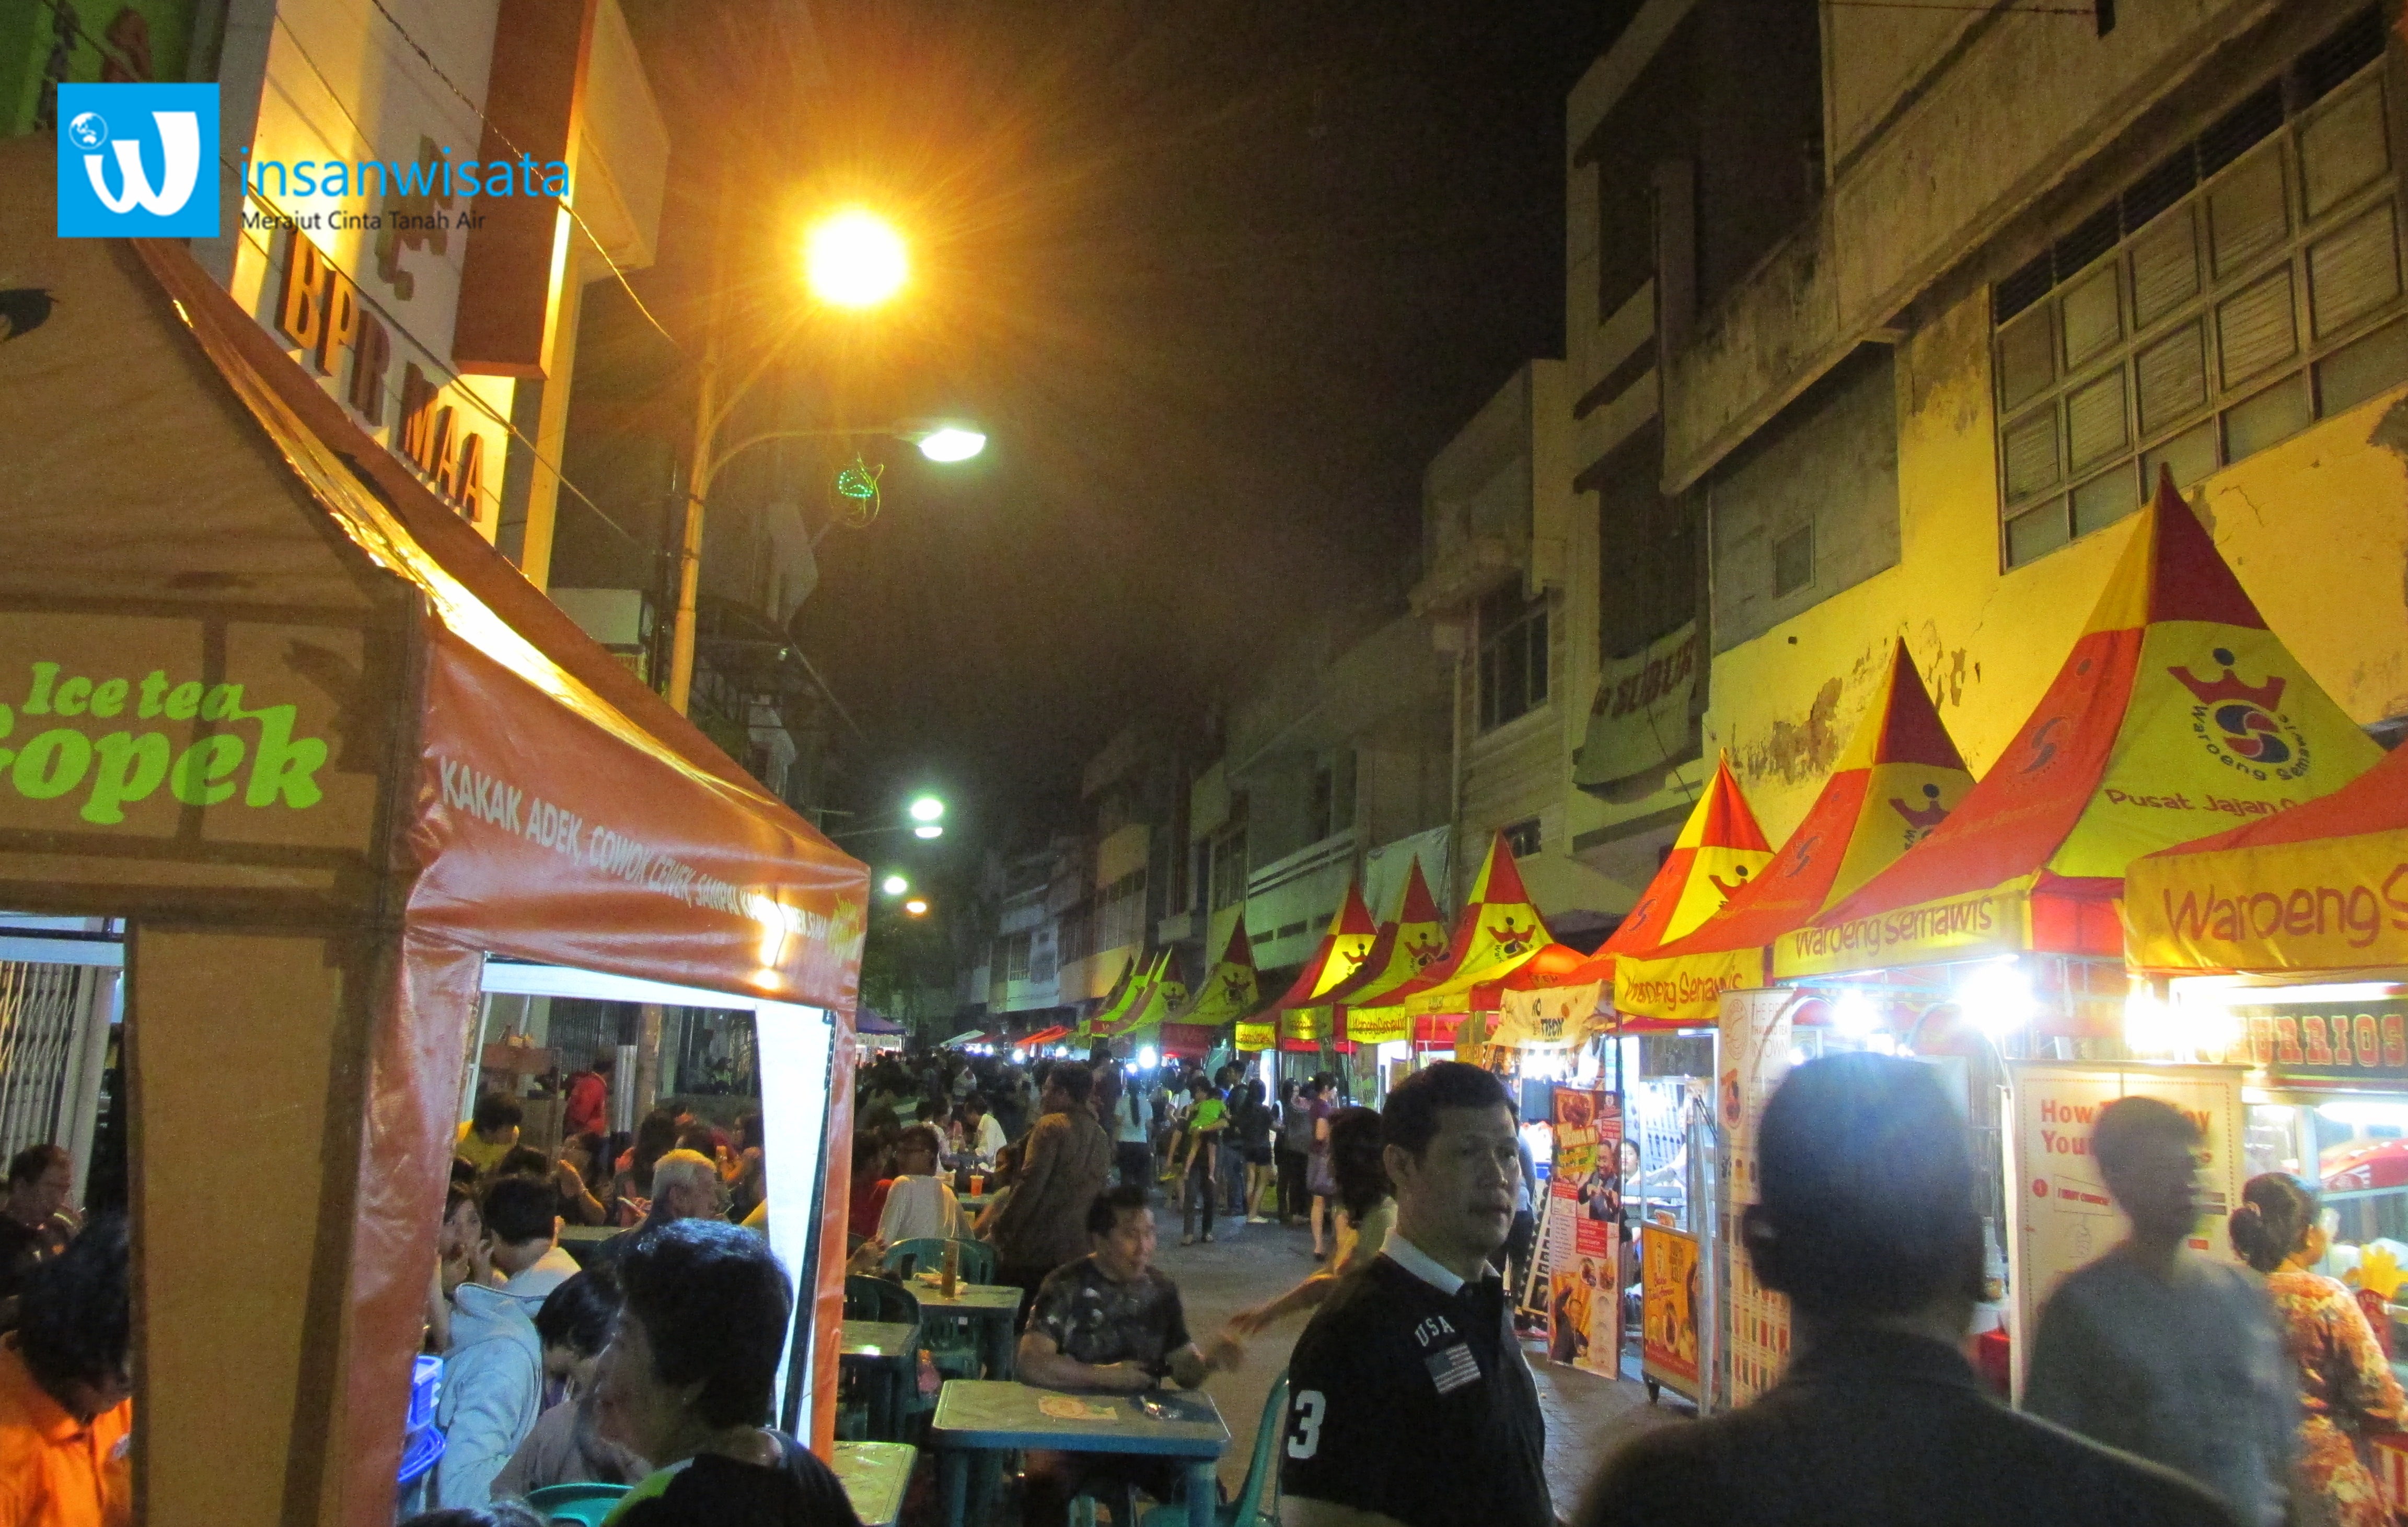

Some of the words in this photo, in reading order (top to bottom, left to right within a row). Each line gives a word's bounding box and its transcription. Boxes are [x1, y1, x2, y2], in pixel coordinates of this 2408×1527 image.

[22, 661, 130, 718] Ice
[138, 671, 245, 721] tea
[0, 704, 328, 825] opek
[440, 756, 522, 835] KAKAK
[525, 798, 586, 866] ADEK,
[589, 825, 653, 885] COWOK
[2104, 788, 2196, 811] Pusat
[2203, 794, 2276, 817] Jajan
[2163, 883, 2381, 948] Waroeng
[2040, 1098, 2093, 1124] How
[1414, 1315, 1455, 1347] USA
[1287, 1390, 1326, 1460] 3
